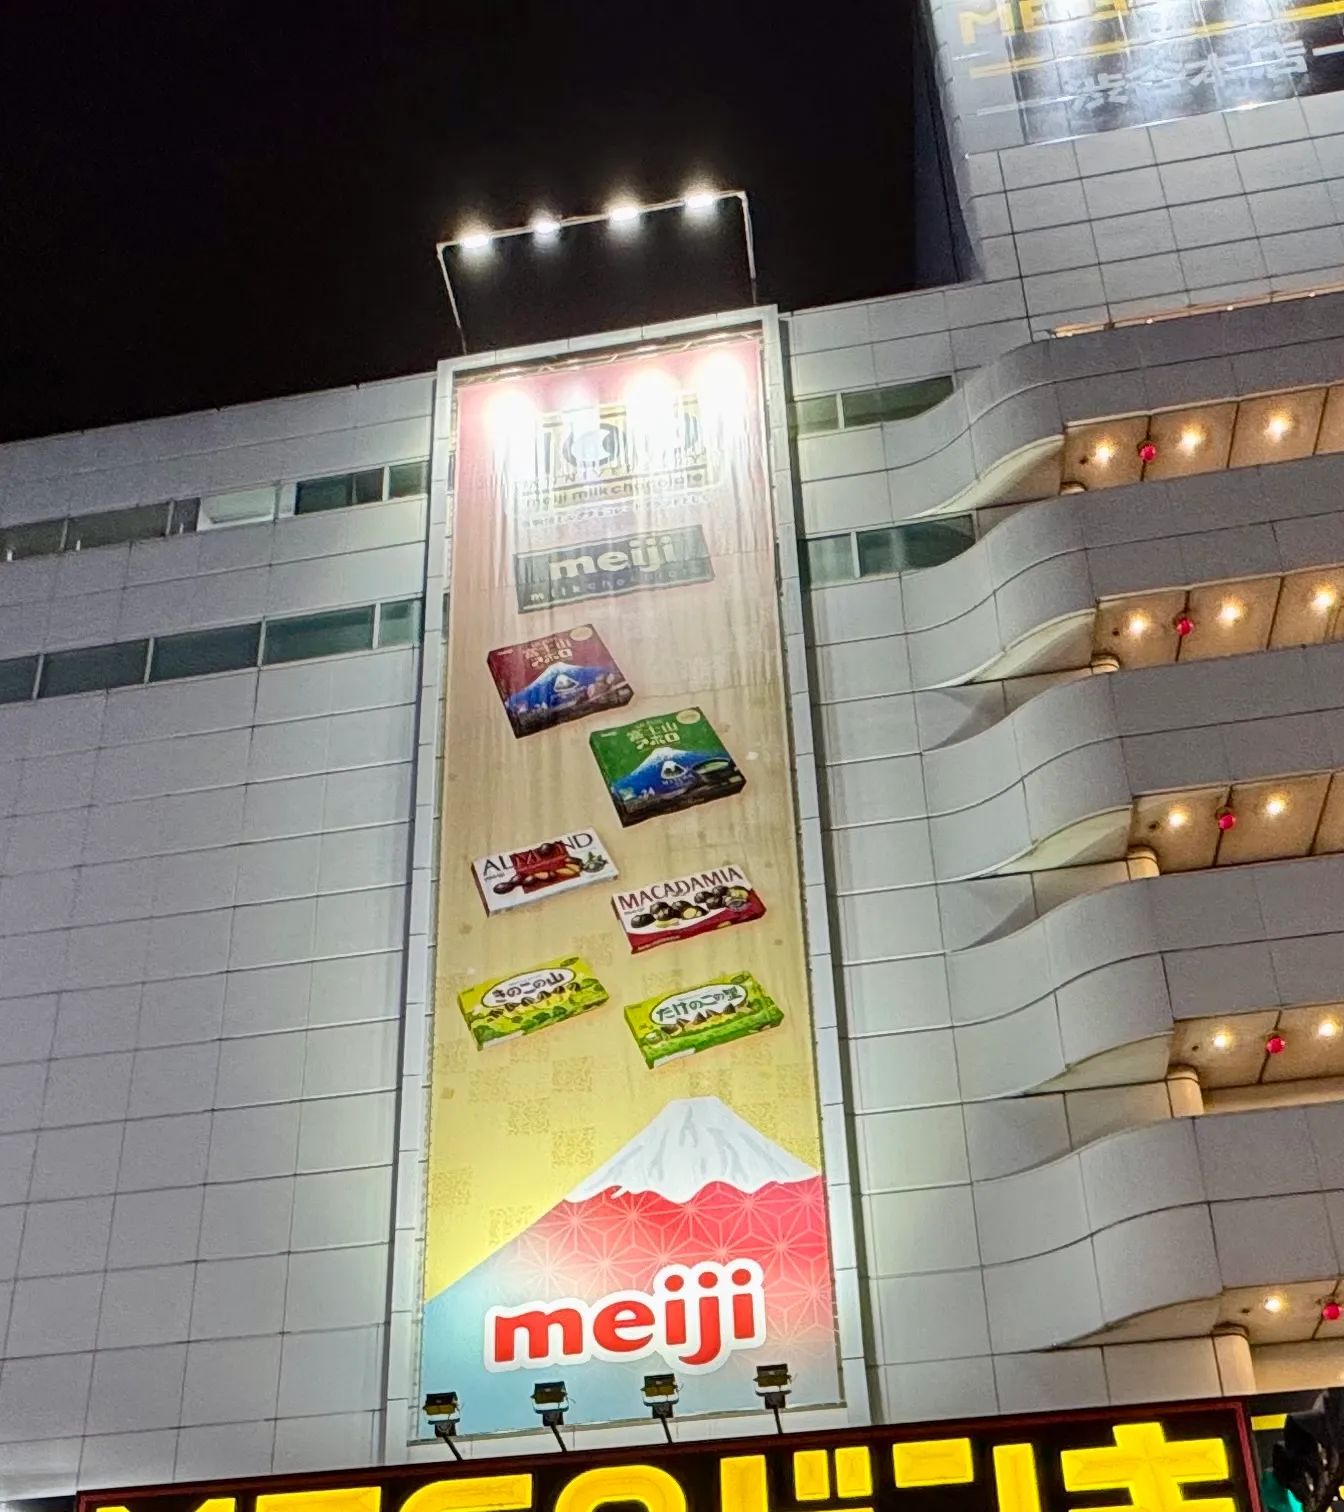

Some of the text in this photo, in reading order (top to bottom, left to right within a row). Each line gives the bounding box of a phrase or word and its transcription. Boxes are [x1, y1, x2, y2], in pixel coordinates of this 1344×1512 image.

[548, 535, 676, 581] meiji
[617, 866, 744, 911] MACADAMIA
[492, 971, 566, 1004] きのこの山
[656, 986, 743, 1023] たけのこの里
[494, 1268, 757, 1366] meiji
